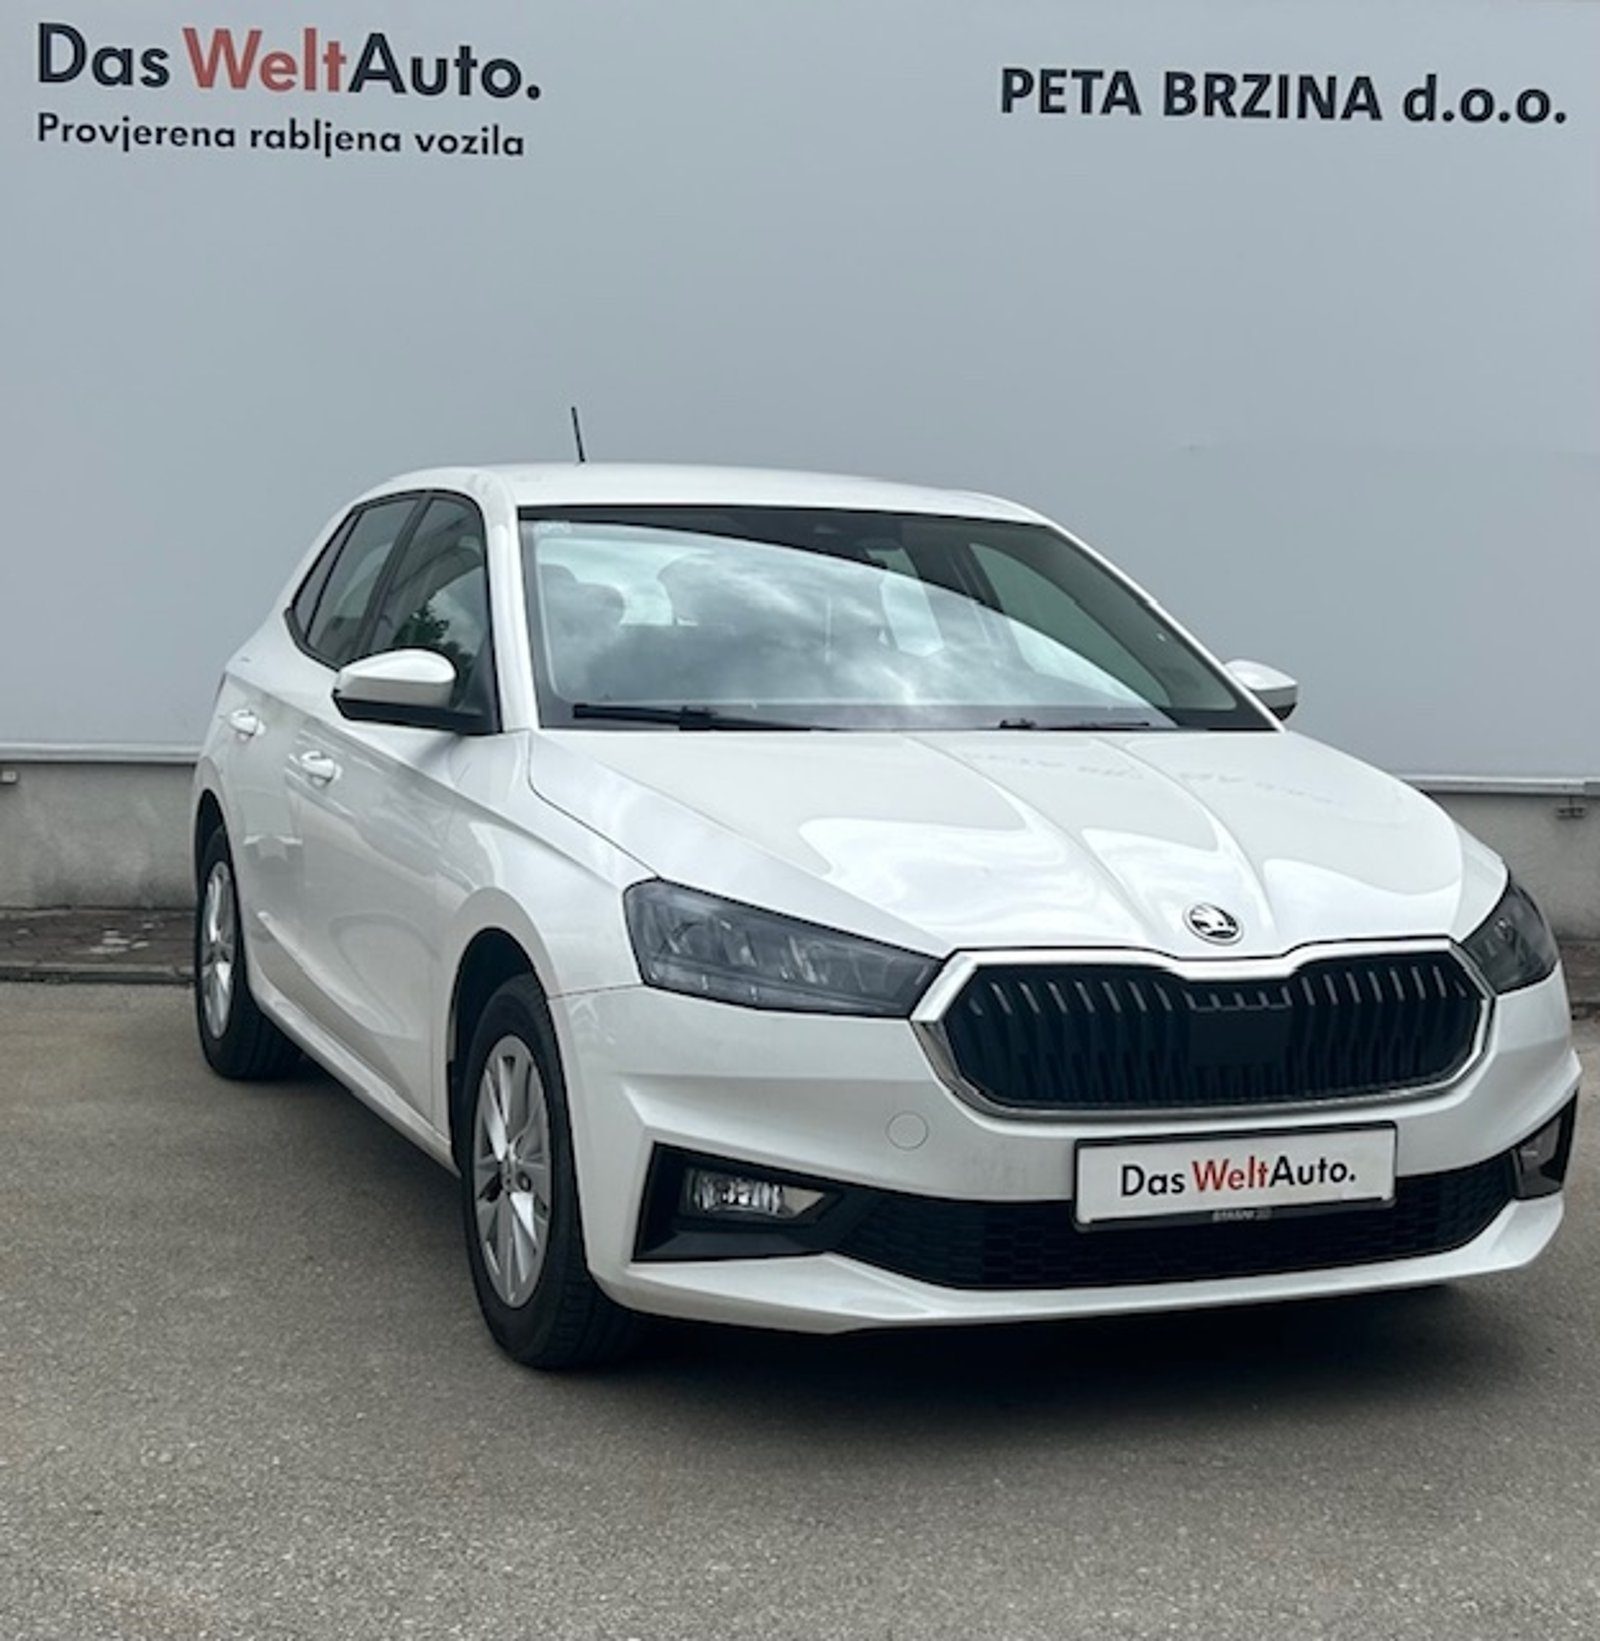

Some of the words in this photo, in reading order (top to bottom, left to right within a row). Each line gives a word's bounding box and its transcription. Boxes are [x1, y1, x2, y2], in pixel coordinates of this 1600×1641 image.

[38, 21, 171, 89] Das
[182, 27, 542, 101] WeltAuto.
[1001, 67, 1142, 116] PETA
[1163, 70, 1383, 122] BRZINA
[1402, 73, 1567, 125] d.o.o.
[38, 112, 236, 153] Provjerena
[250, 117, 401, 159] rabljena
[414, 123, 524, 157] vozila
[1121, 1164, 1186, 1197] Das
[1191, 1155, 1356, 1193] WeltAuto.
